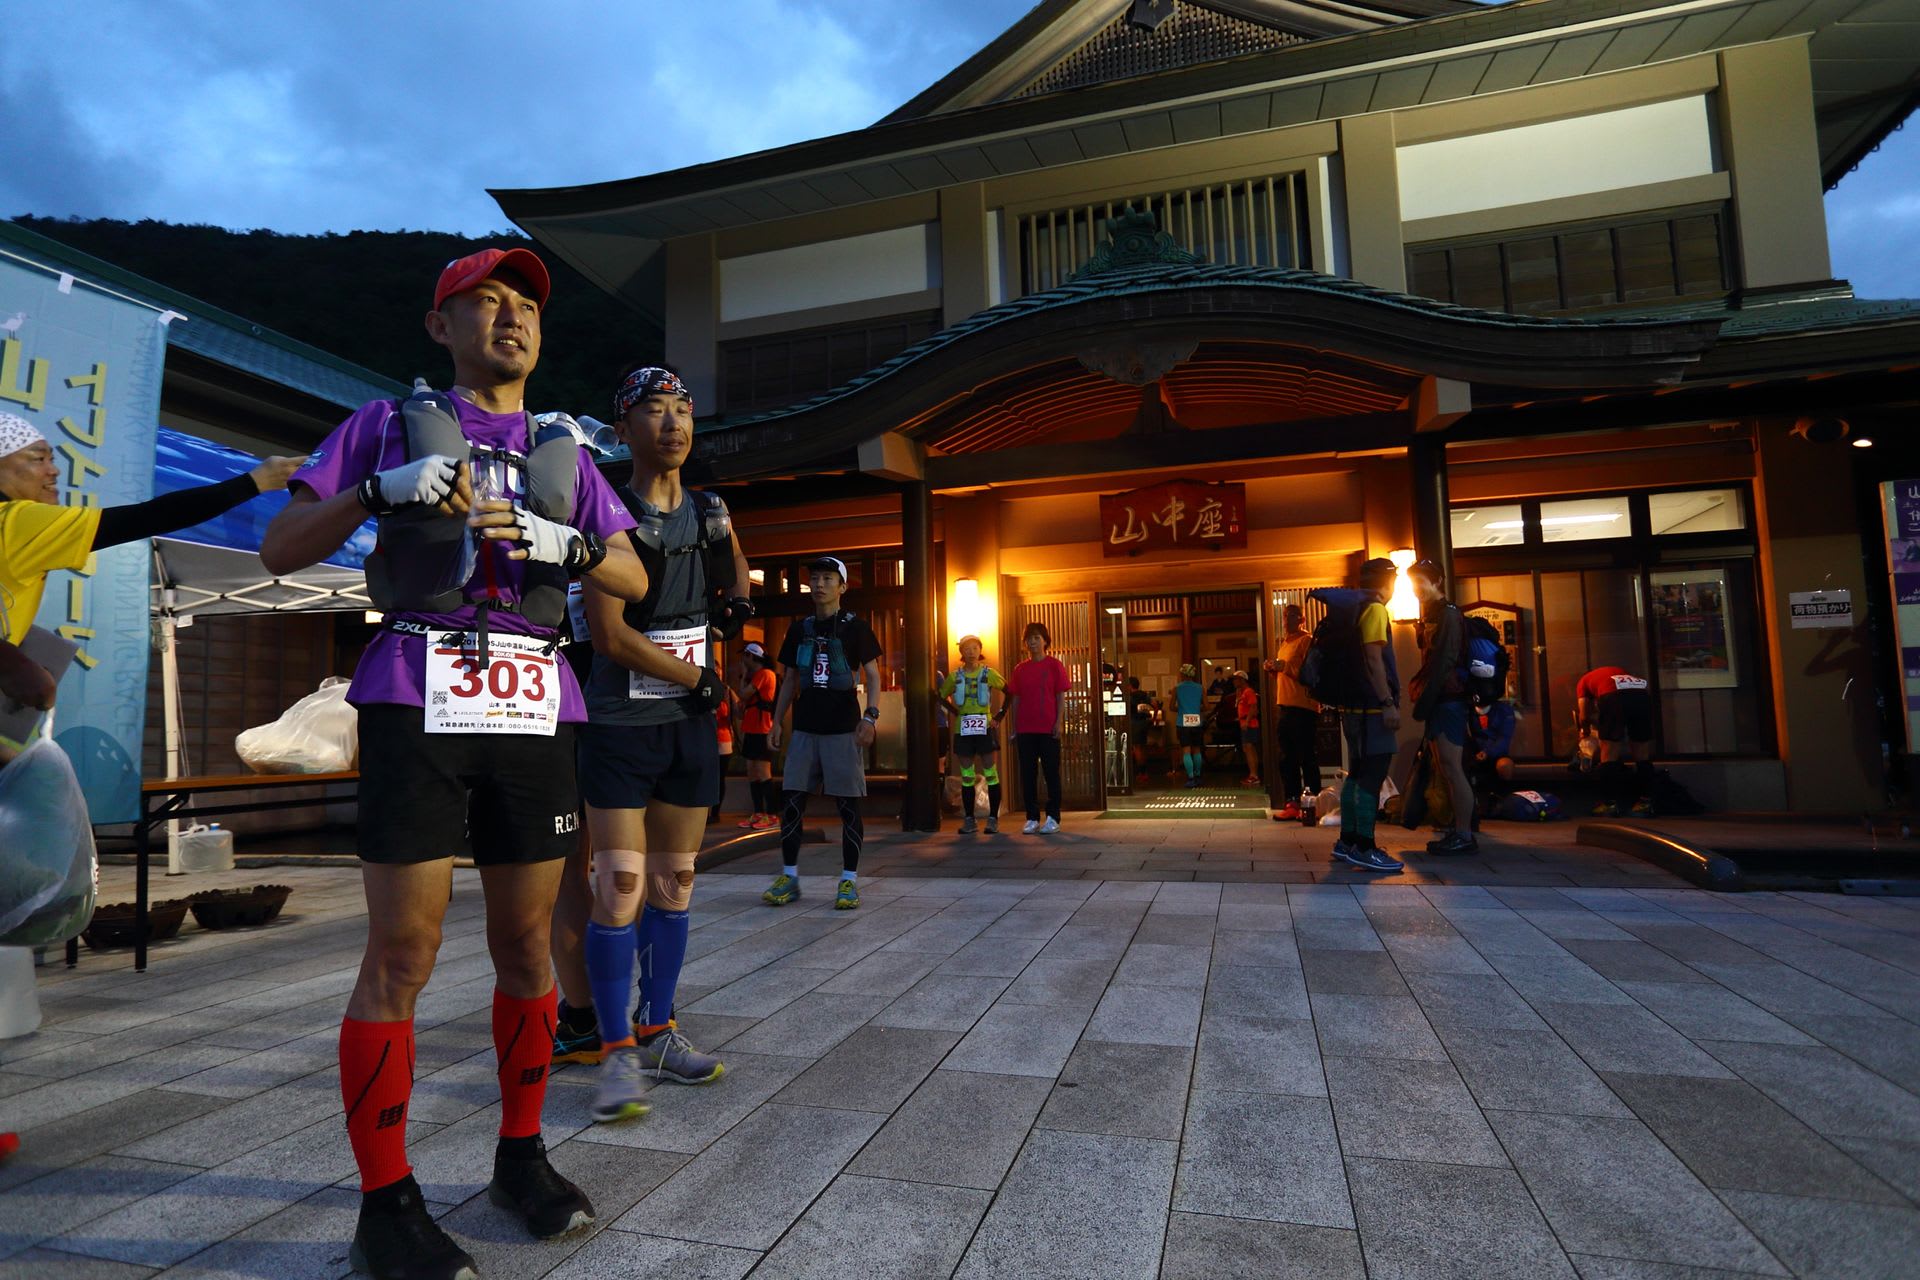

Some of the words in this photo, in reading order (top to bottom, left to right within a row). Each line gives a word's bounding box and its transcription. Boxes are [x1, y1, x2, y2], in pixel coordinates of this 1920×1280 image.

[1110, 495, 1225, 545] 山中座
[392, 620, 432, 635] 2XU
[449, 658, 546, 702] 303
[963, 719, 984, 729] 322
